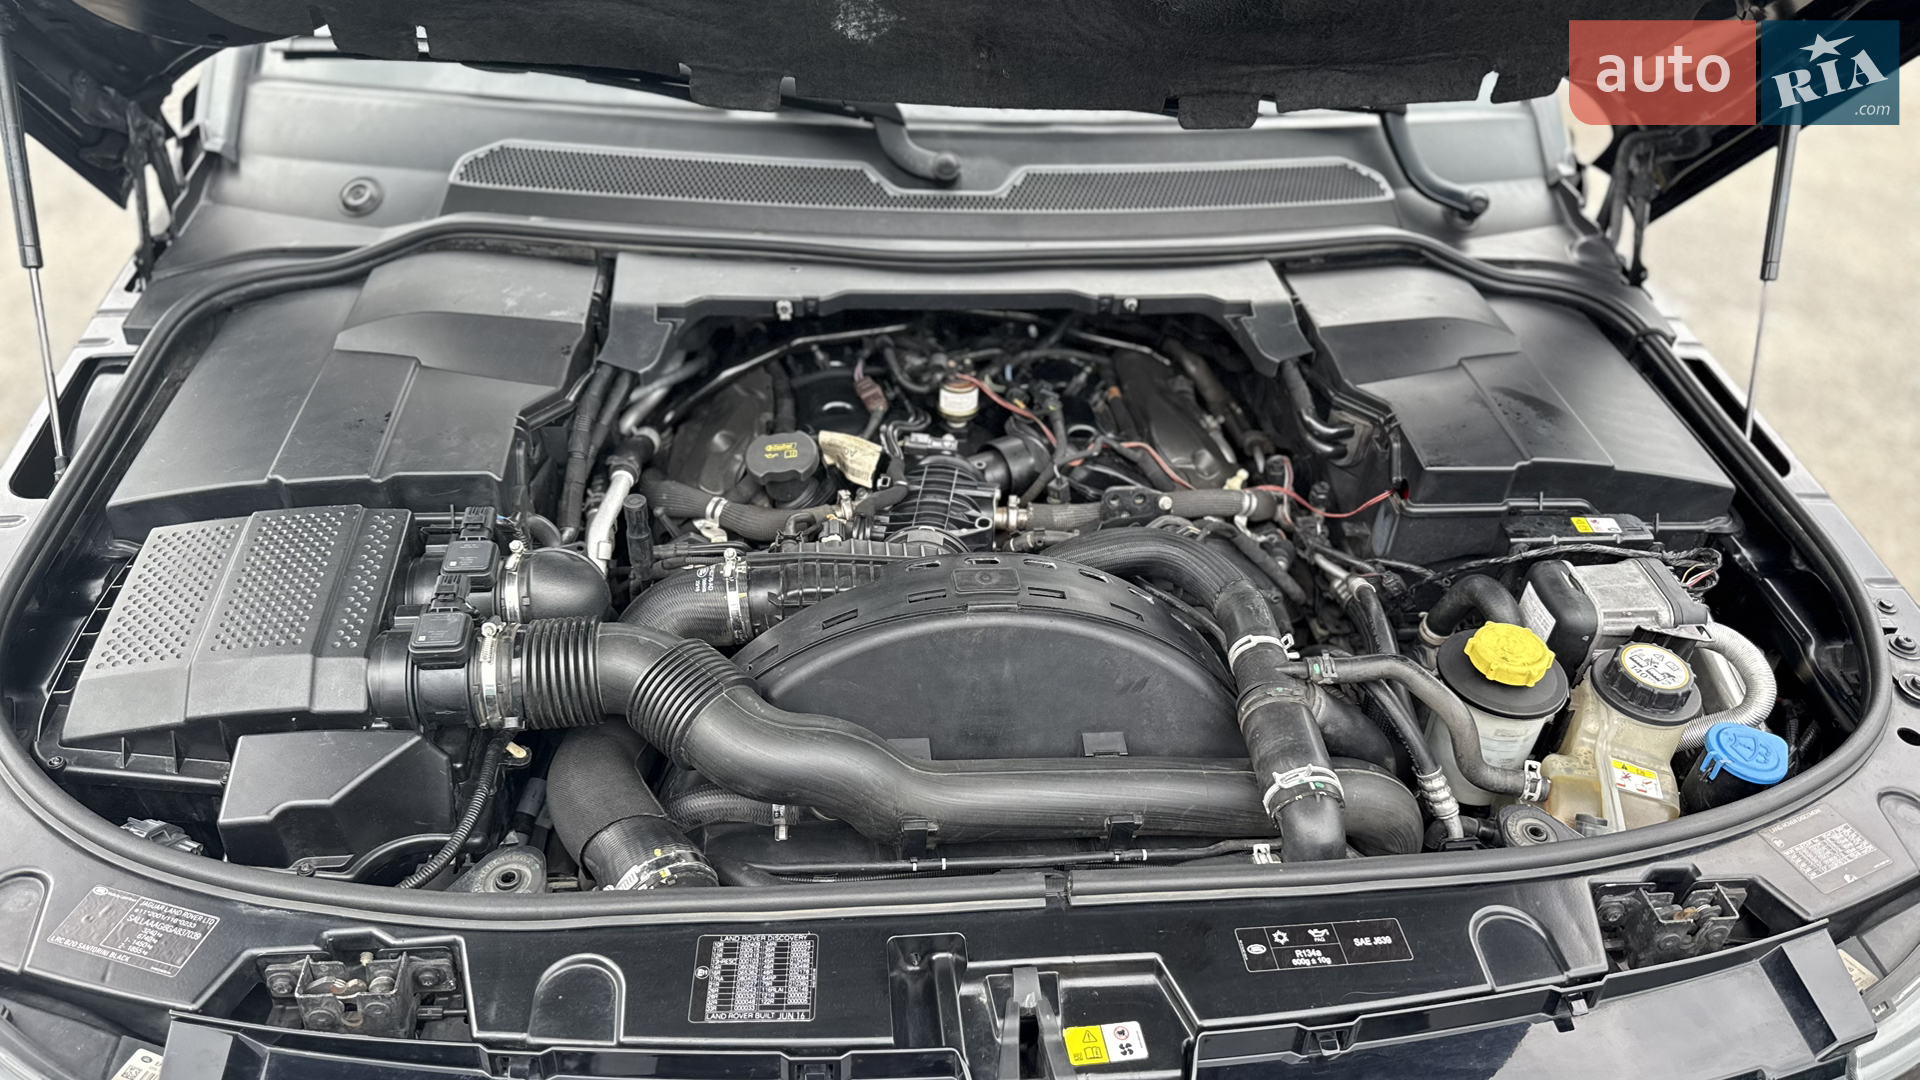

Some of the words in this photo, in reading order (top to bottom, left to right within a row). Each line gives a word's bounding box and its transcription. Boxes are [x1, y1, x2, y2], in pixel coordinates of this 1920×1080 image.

[139, 900, 166, 911] JAGUAR
[164, 906, 183, 916] LAND
[181, 911, 203, 922] ROVER
[201, 917, 216, 925] LTD
[1353, 937, 1372, 947] SAE
[1373, 935, 1392, 945] J639
[50, 935, 65, 944] LRC
[76, 942, 110, 956] SANTORINI
[108, 950, 131, 962] BLACK
[1295, 948, 1323, 958] R134a
[1317, 956, 1332, 965] 10g
[706, 1012, 727, 1020] LAND
[777, 1011, 794, 1020] JUN
[796, 1011, 806, 1020] 16
